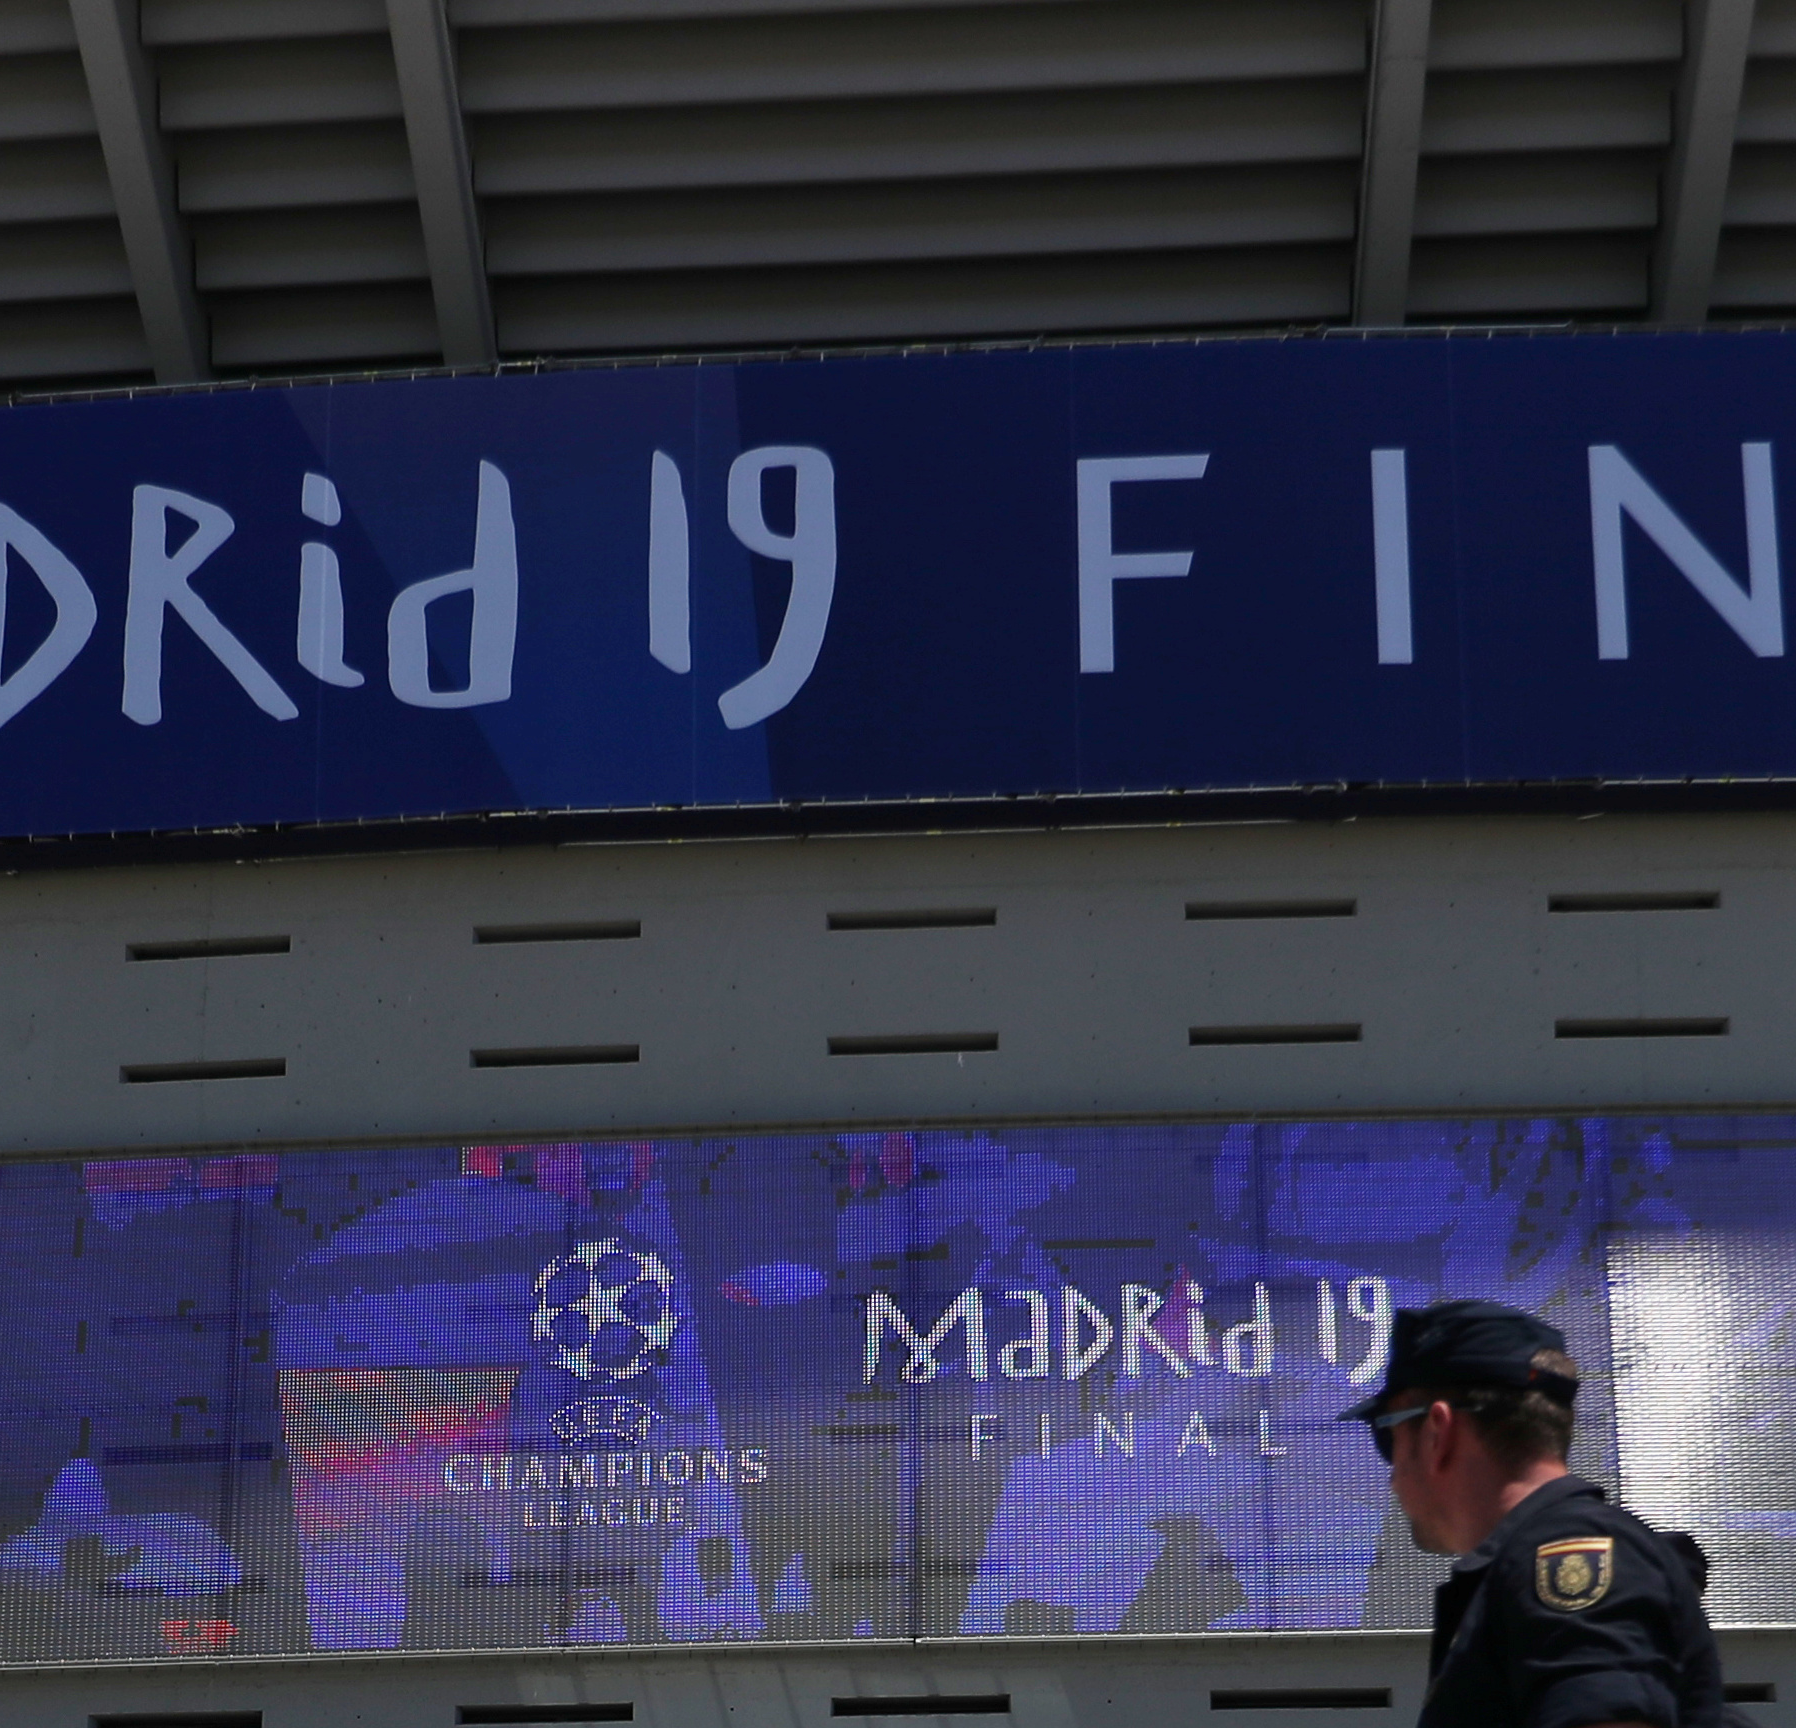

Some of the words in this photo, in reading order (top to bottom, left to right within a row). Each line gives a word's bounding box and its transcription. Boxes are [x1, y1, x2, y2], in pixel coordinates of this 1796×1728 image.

[649, 446, 836, 729] 19
[1317, 1276, 1393, 1385] 19
[971, 1409, 1288, 1460] FINAL
[443, 1449, 769, 1494] CHAMPIONS
[524, 1498, 686, 1528] LEAGUE
